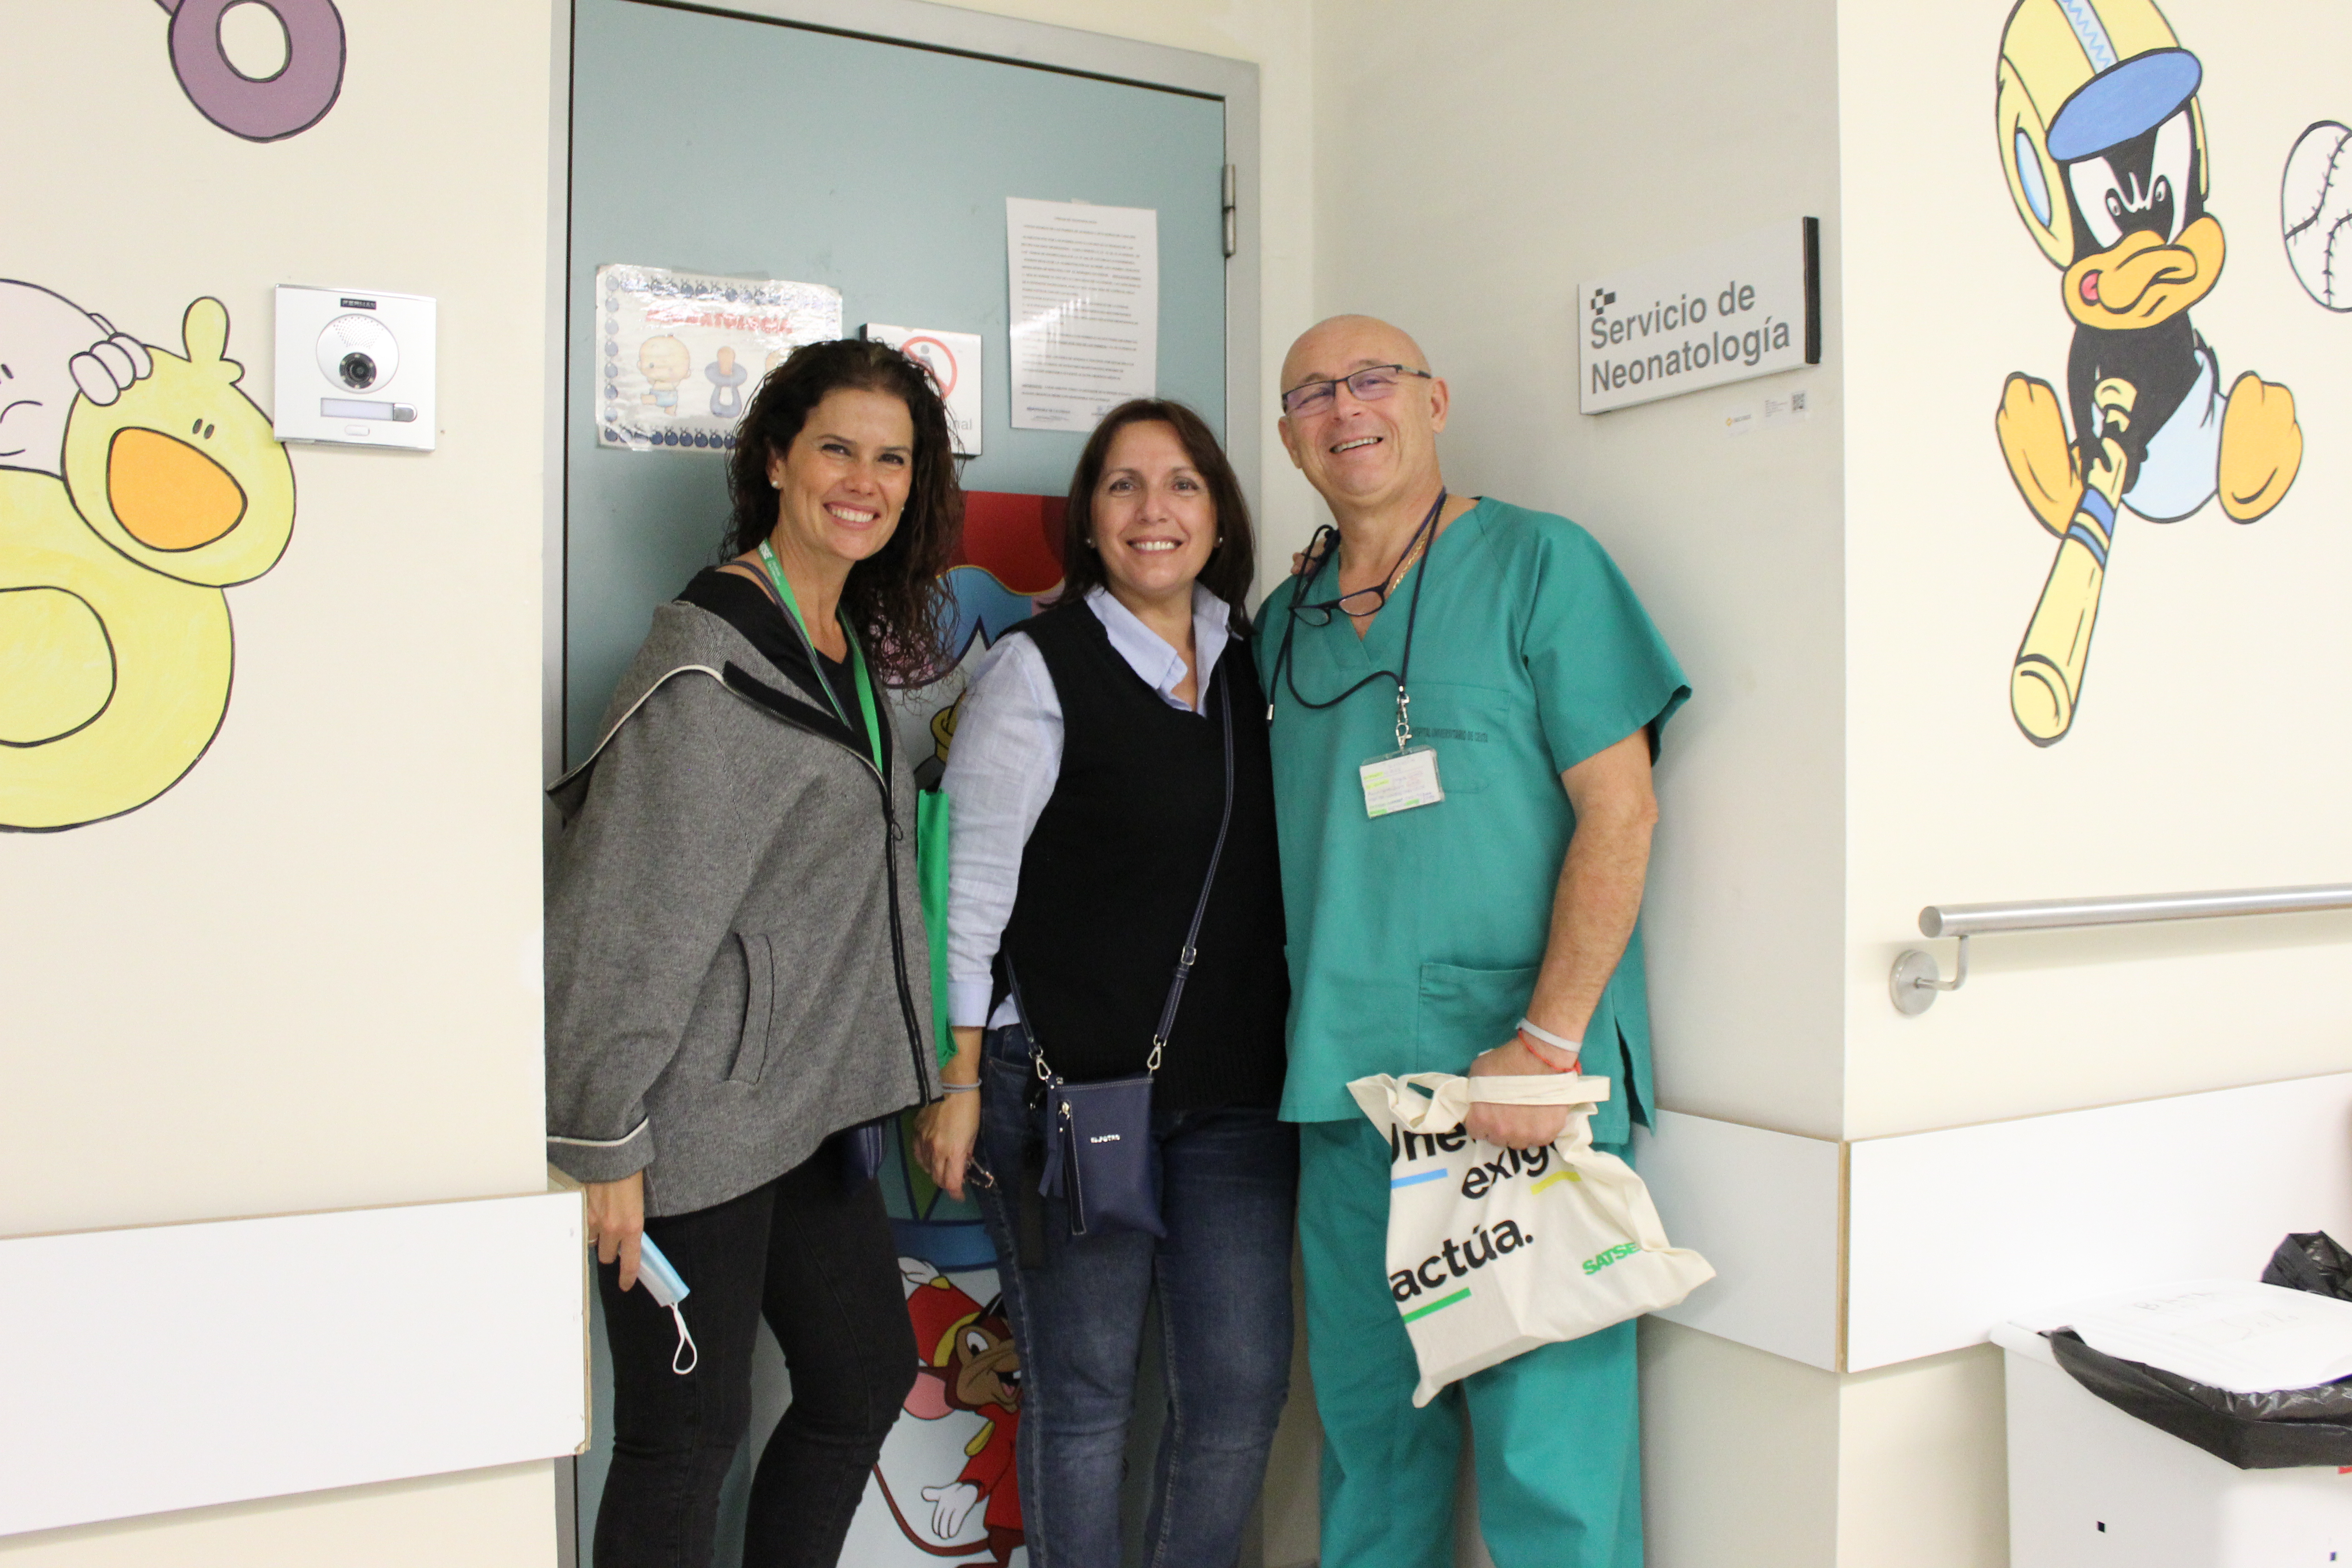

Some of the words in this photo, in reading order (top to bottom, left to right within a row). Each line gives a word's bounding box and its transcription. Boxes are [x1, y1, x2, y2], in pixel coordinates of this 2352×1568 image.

[1591, 293, 1707, 349] Servicio
[1718, 280, 1756, 316] de
[1592, 316, 1790, 394] Neonatología
[1461, 1141, 1557, 1200] exig
[1389, 1220, 1534, 1302] actúa.
[1582, 1243, 1642, 1275] SATSE
